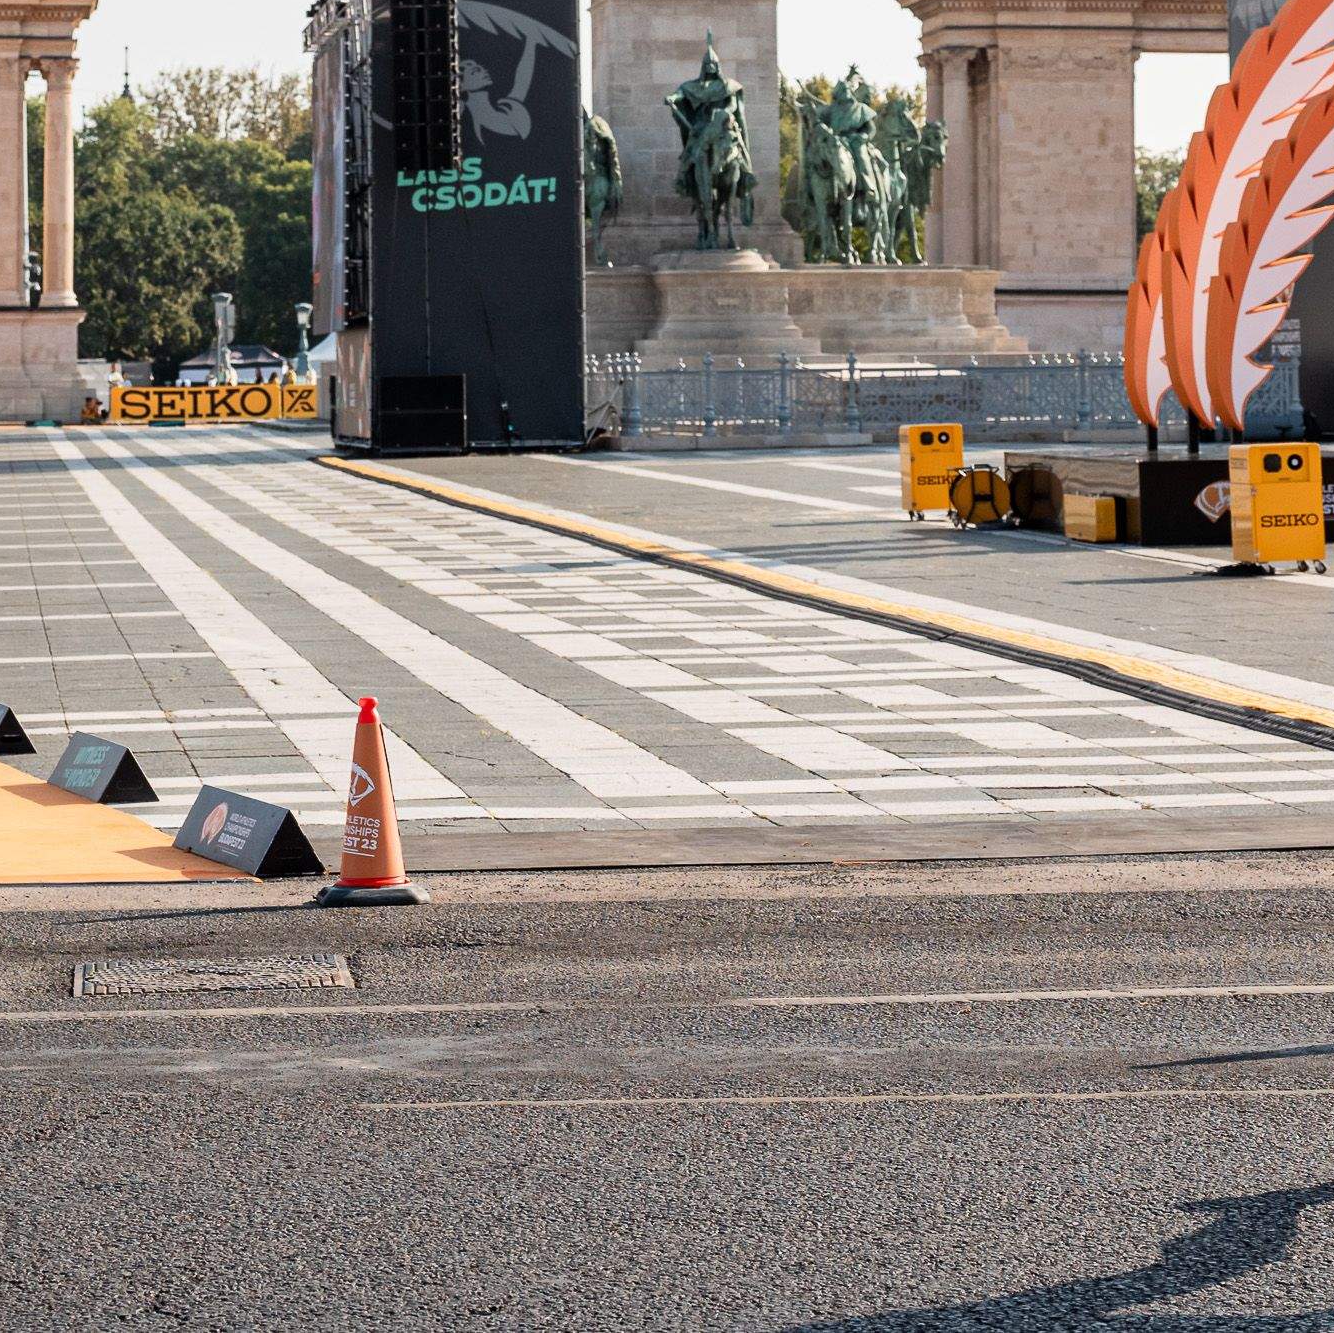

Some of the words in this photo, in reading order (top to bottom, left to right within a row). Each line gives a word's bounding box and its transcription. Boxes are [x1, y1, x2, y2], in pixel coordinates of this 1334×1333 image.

[411, 174, 557, 212] CSODÁT!
[120, 387, 272, 419] SEIKO
[917, 475, 953, 486] SEIK
[1260, 513, 1319, 528] SEIKO
[361, 839, 378, 850] 23
